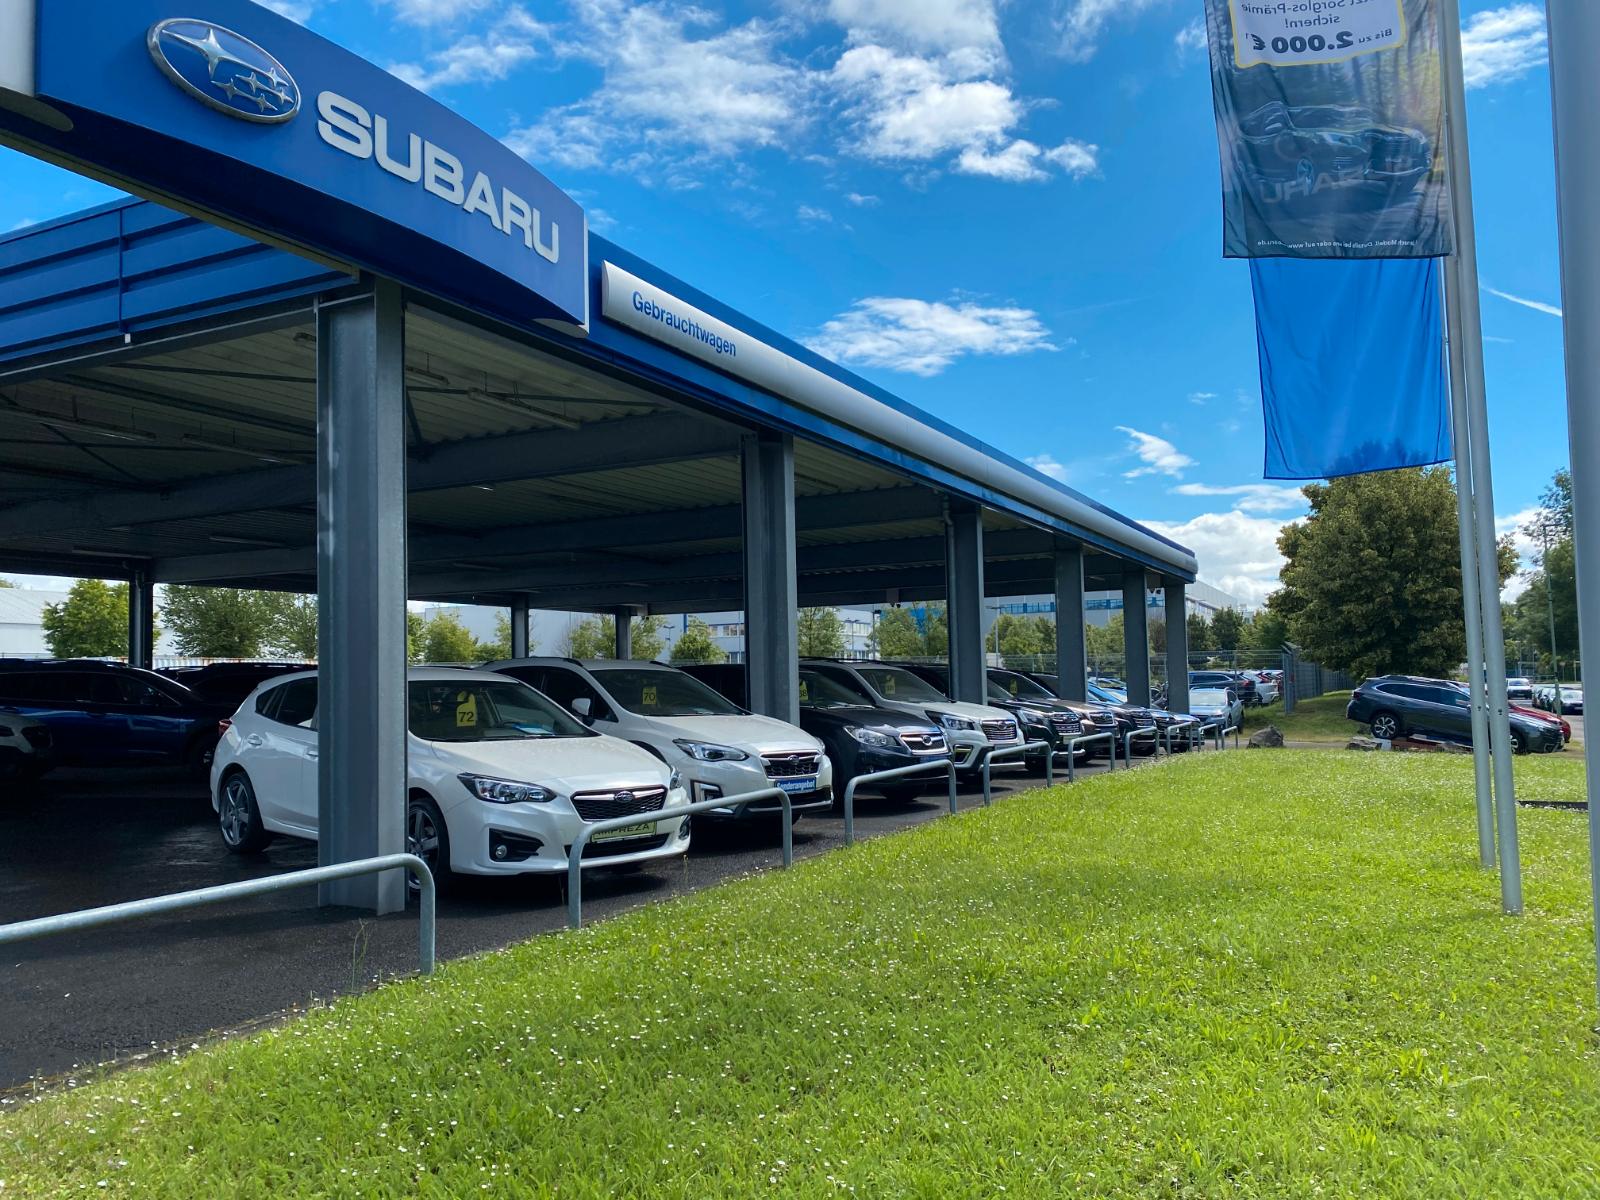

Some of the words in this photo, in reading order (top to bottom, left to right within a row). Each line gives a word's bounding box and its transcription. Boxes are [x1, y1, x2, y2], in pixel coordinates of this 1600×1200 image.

[317, 91, 559, 264] SUBARU
[632, 291, 736, 357] Gebrauchtwagen
[644, 692, 656, 702] 70
[458, 711, 475, 723] 72
[598, 822, 650, 836] PREZA
